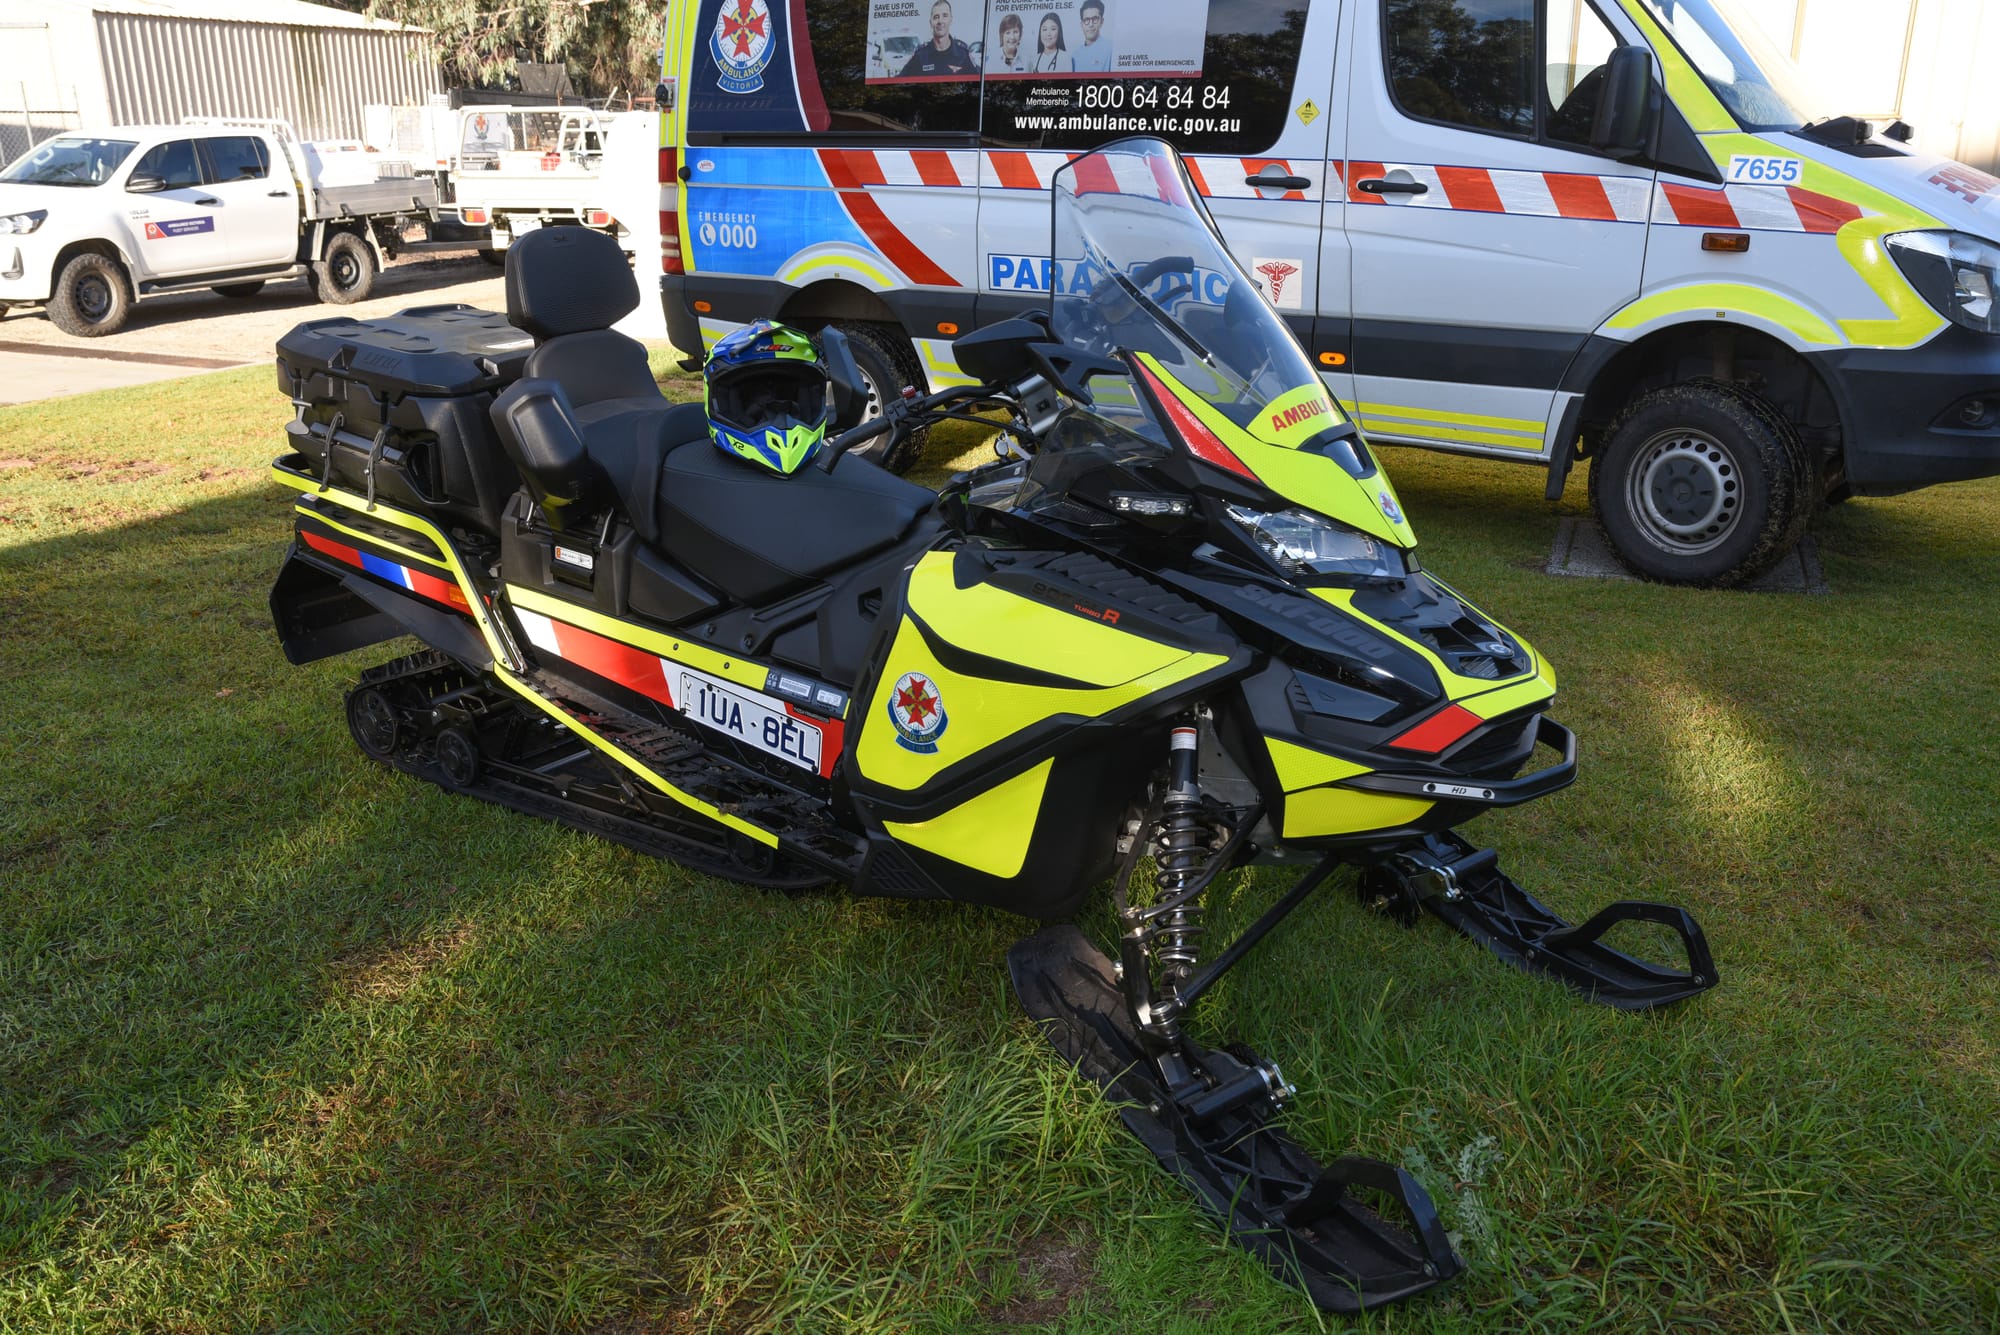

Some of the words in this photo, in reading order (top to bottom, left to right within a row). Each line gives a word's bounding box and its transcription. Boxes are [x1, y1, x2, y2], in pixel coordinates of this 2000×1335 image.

[874, 10, 920, 18] EMERGENCIES.
[718, 58, 765, 78] AMBULANCE
[722, 79, 759, 89] VICTORIA
[1031, 87, 1069, 95] Ambulance
[1026, 97, 1069, 106] Membership
[1075, 85, 1124, 108] 1800
[1132, 85, 1158, 109] 64
[1166, 85, 1194, 109] 84
[1202, 85, 1230, 109] 84
[1014, 114, 1241, 135] www.ambulance.vic.gov.au
[1734, 157, 1798, 181] 7655
[699, 211, 757, 224] EMERGENCY
[720, 223, 757, 249] 000
[699, 687, 745, 734] 1UA
[762, 715, 816, 766] 8EL
